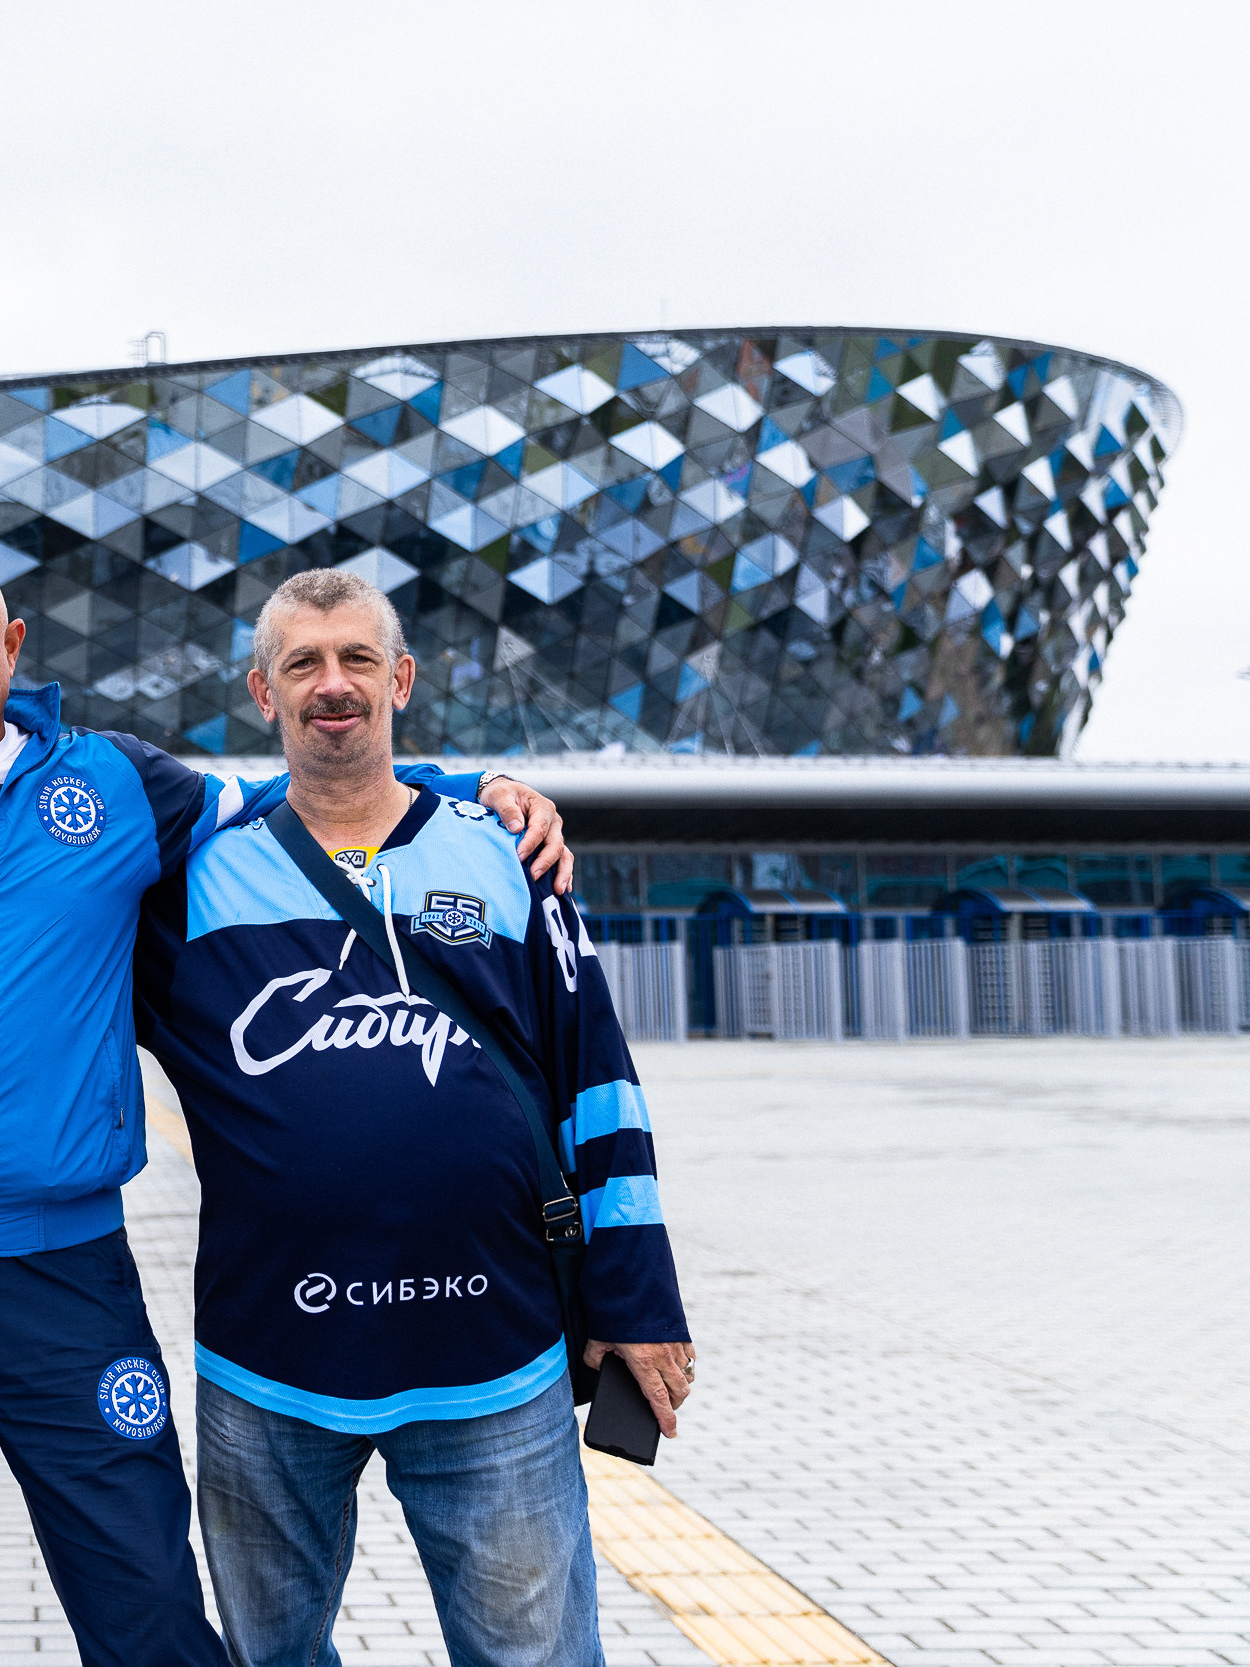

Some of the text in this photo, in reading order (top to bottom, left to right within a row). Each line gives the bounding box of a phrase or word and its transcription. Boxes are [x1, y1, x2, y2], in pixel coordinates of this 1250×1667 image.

[39, 776, 104, 810] SIBIR HOCKEY CLUB
[49, 825, 101, 844] NOVOSIBIRSK
[230, 967, 482, 1087] Сибир
[346, 1274, 489, 1307] СИБЭКО
[99, 1359, 165, 1400] SIBIR HOCKEY CLUB
[112, 1413, 166, 1437] NOVOSIBIRSK
